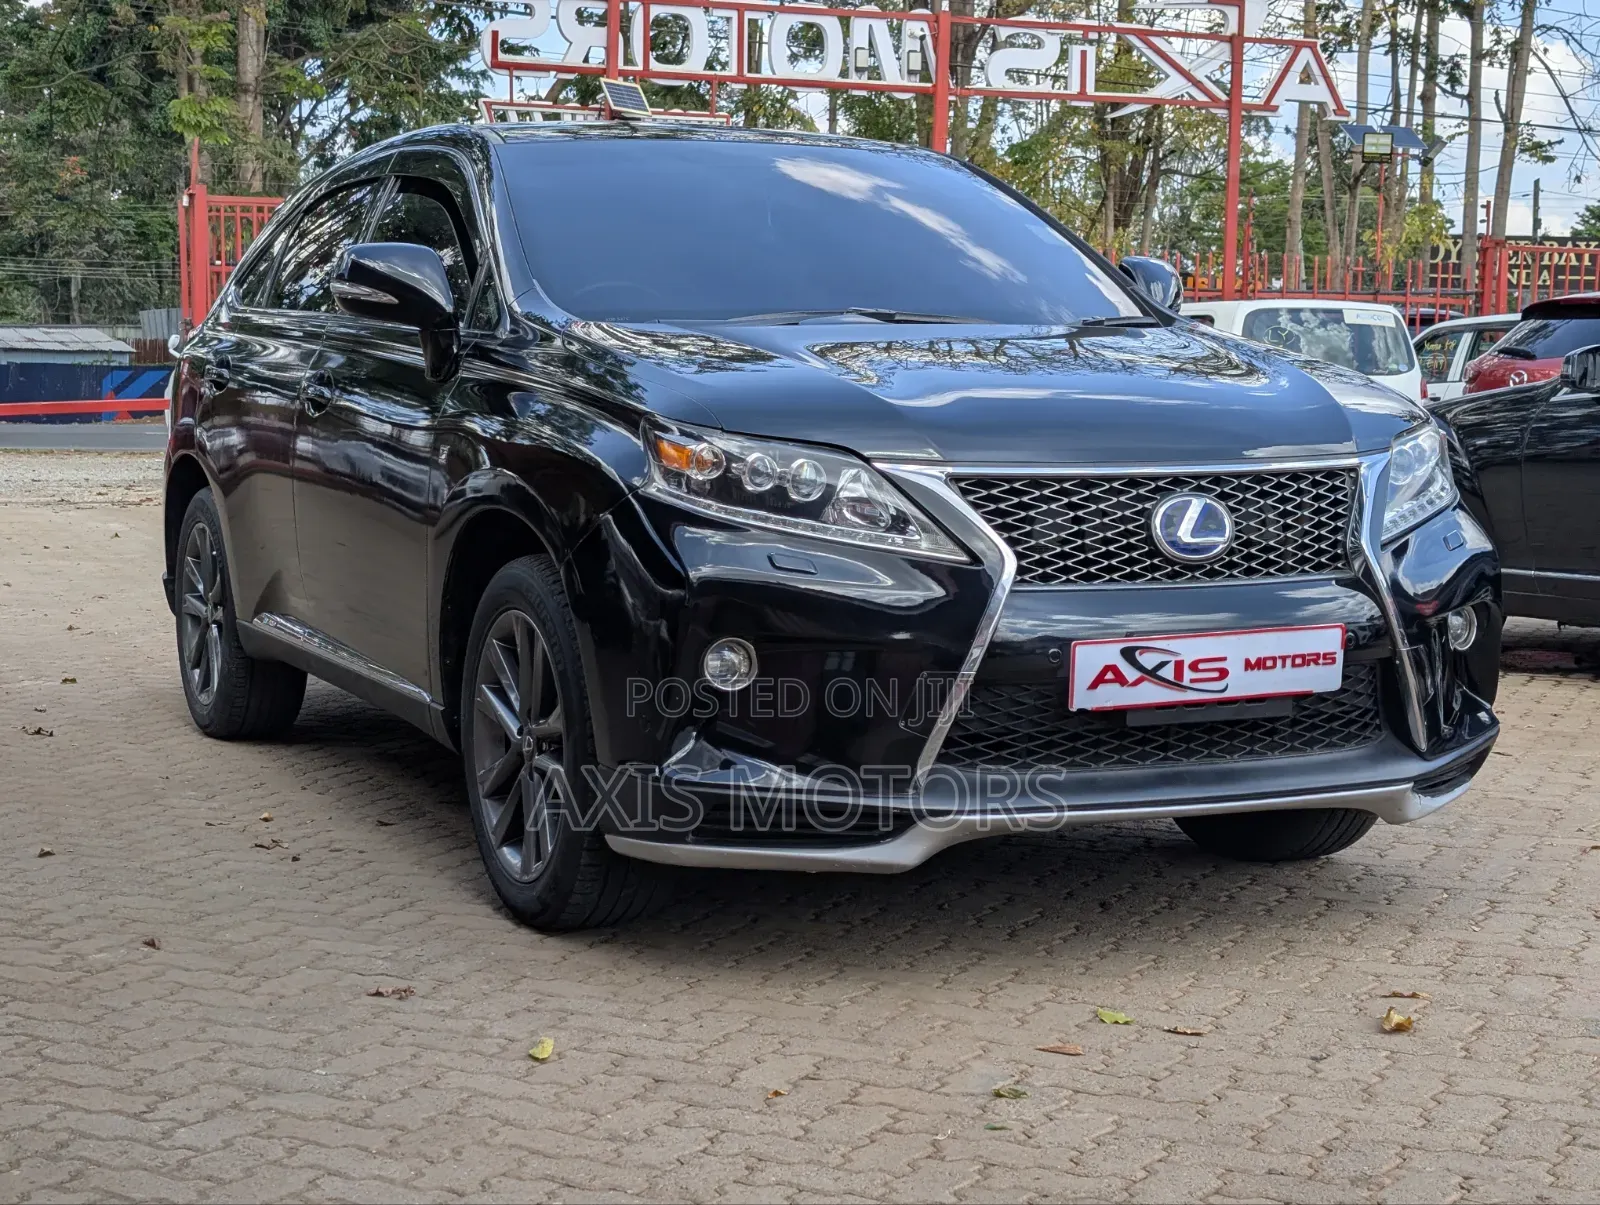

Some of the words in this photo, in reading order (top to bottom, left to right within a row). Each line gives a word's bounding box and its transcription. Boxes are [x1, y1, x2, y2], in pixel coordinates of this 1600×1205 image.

[1540, 240, 1599, 265] BAY
[1086, 645, 1230, 693] AXIS
[1243, 651, 1338, 673] MOTORS
